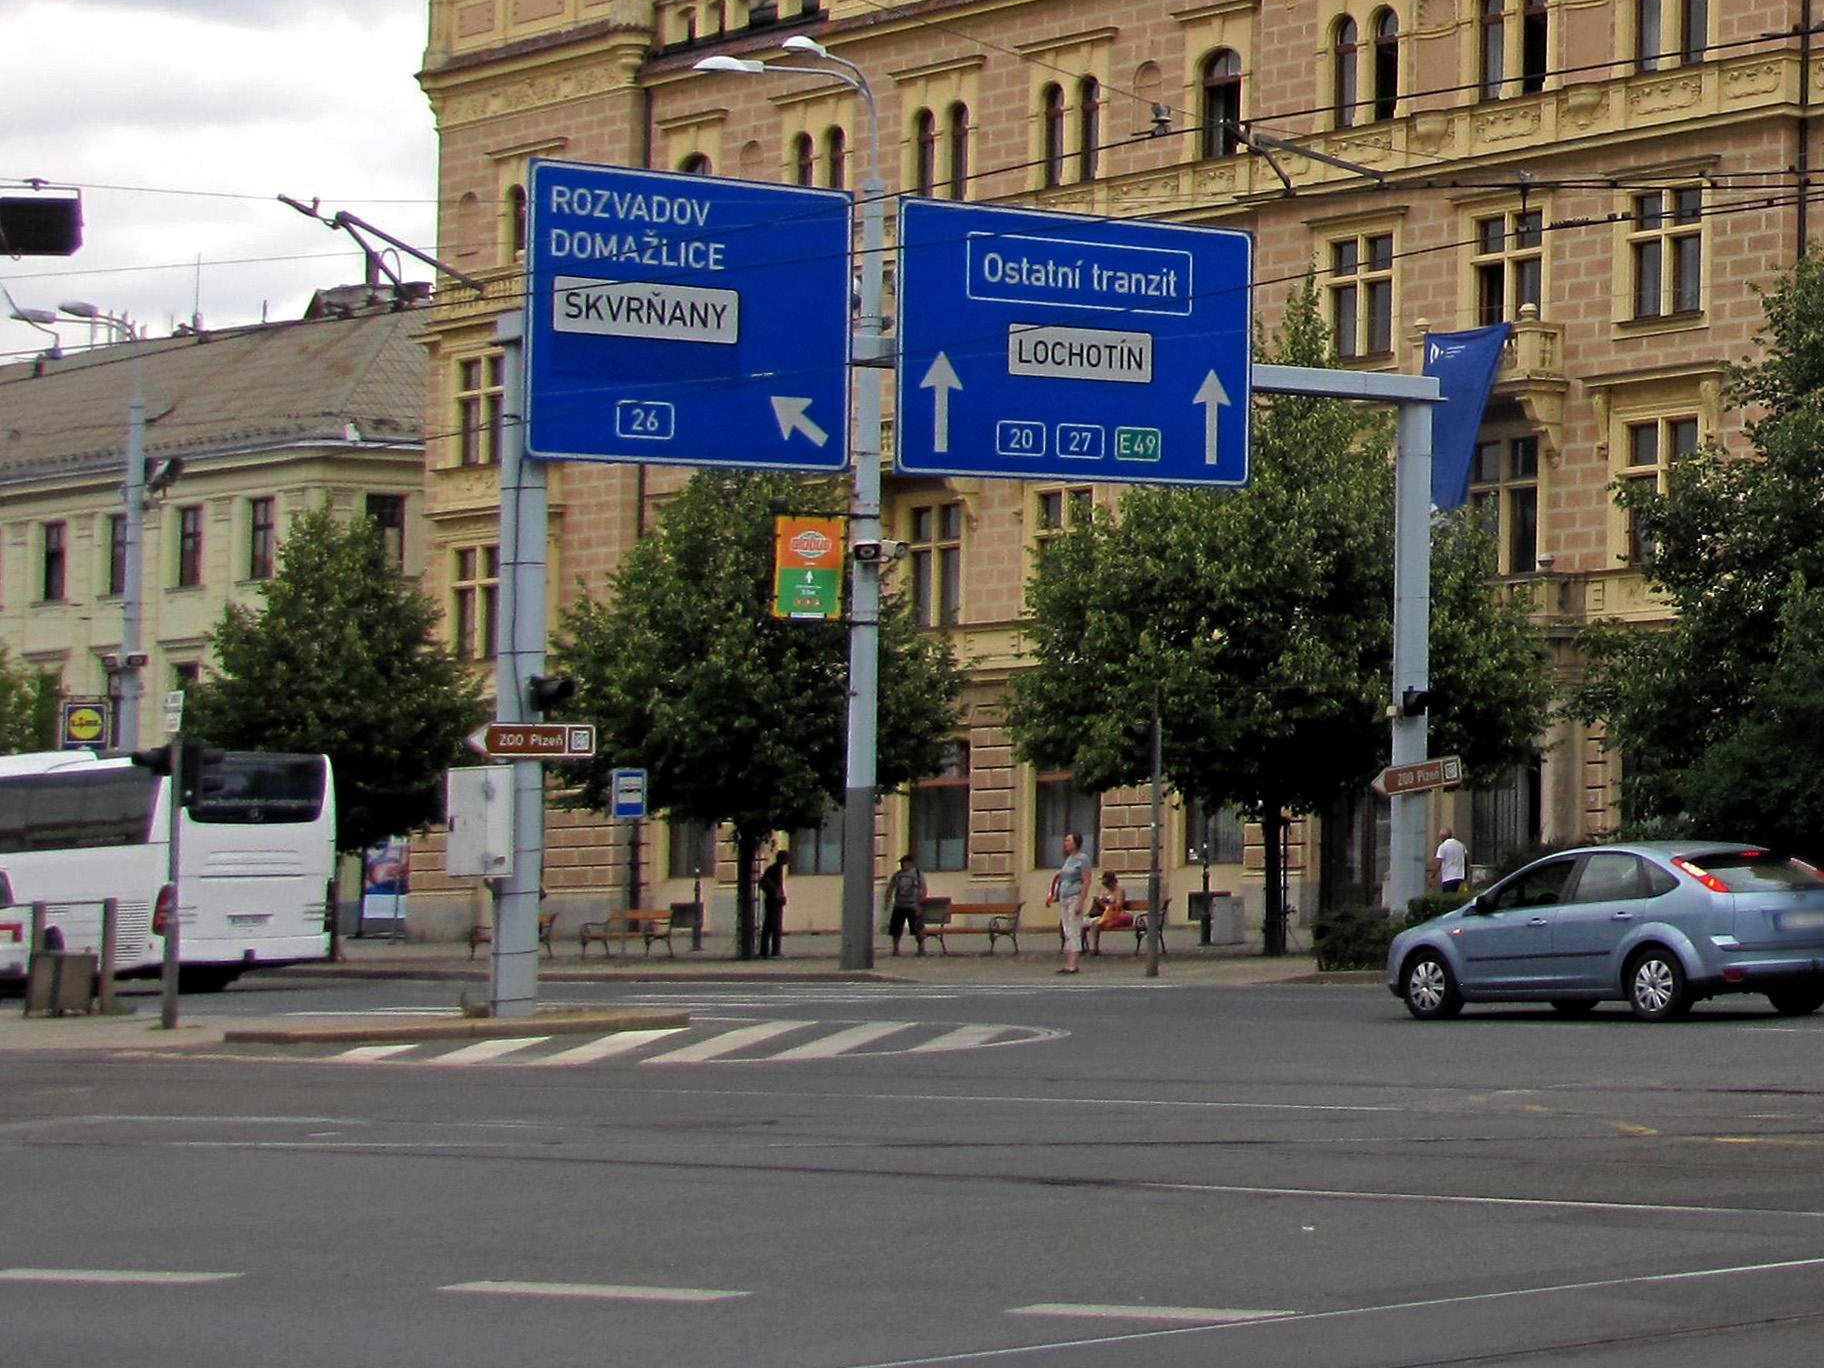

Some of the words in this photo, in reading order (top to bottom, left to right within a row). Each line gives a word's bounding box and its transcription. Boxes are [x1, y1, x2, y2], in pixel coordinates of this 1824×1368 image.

[551, 185, 711, 227] ROZVADOV
[551, 228, 726, 271] DOMAŽLICE
[983, 252, 1083, 289] Ostatní
[1092, 262, 1177, 298] tranzit
[565, 291, 728, 330] SKVRŇANY
[1018, 338, 1144, 371] LOCHOTÍN
[630, 408, 660, 432] 26
[1009, 428, 1033, 449] 20
[1068, 432, 1092, 452] 27
[499, 733, 524, 746] ZOO
[530, 732, 564, 746] Plzeň
